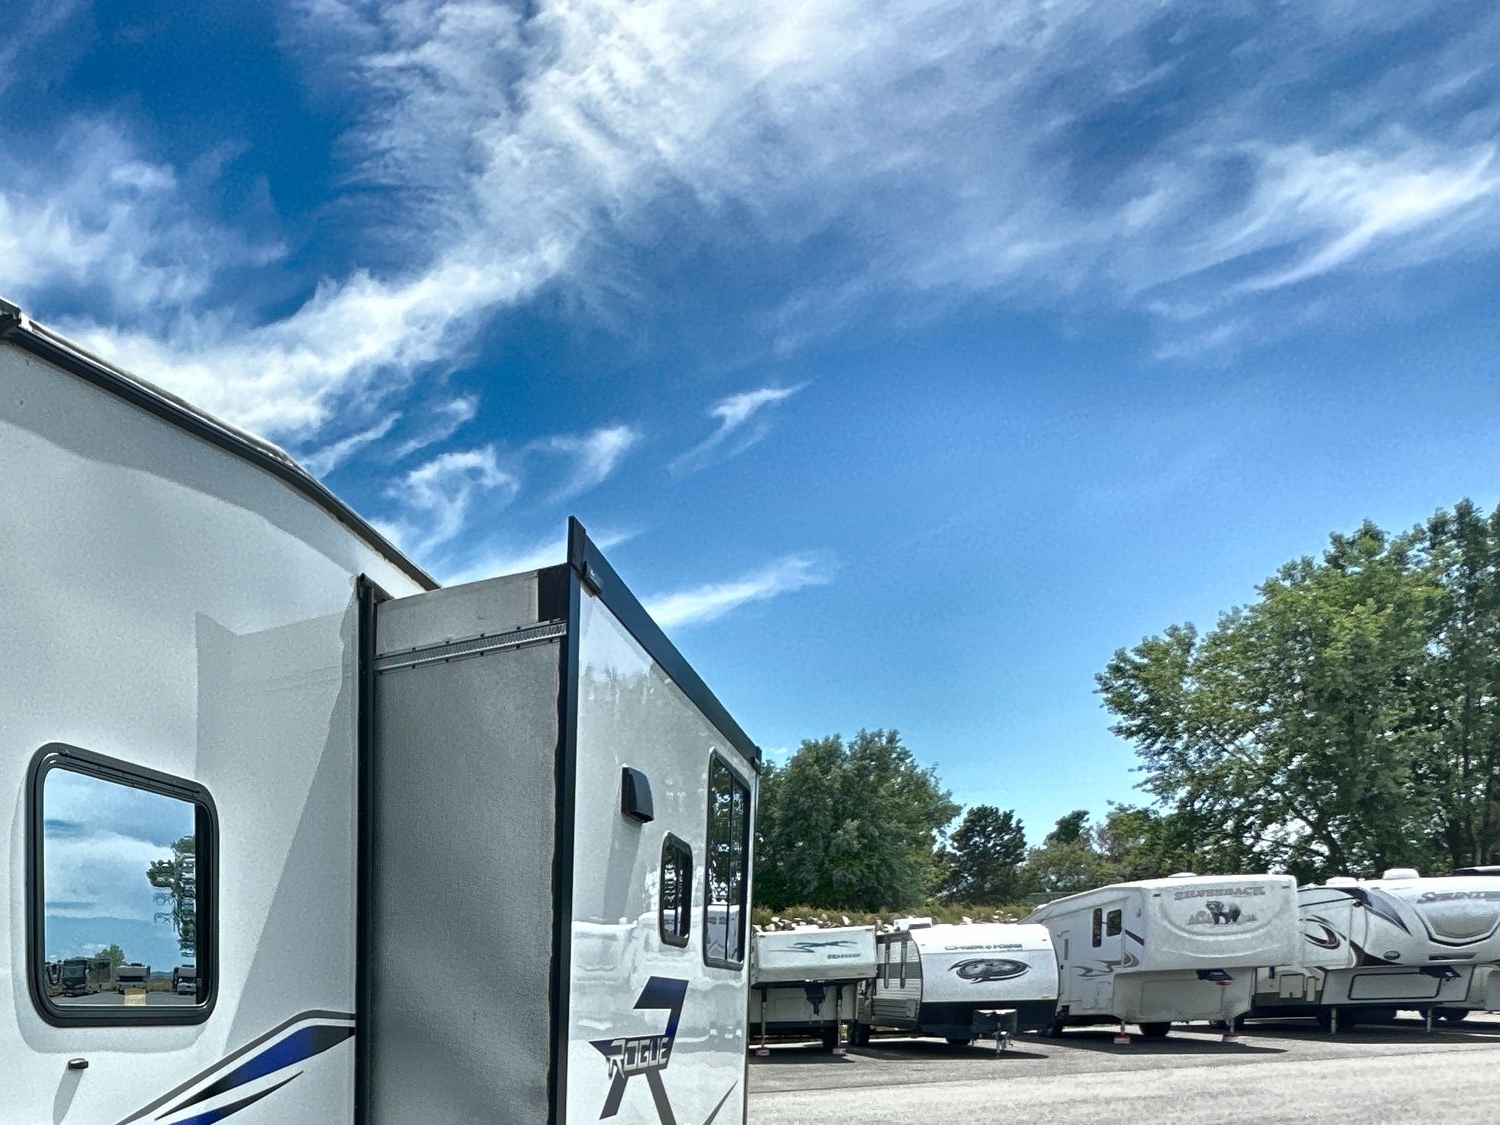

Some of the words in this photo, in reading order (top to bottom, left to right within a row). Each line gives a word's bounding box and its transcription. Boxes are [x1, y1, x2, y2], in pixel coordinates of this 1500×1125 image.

[1174, 886, 1266, 901] SILVERBACK
[1416, 891, 1500, 904] SPRINTE
[606, 1037, 669, 1080] ROGUE
